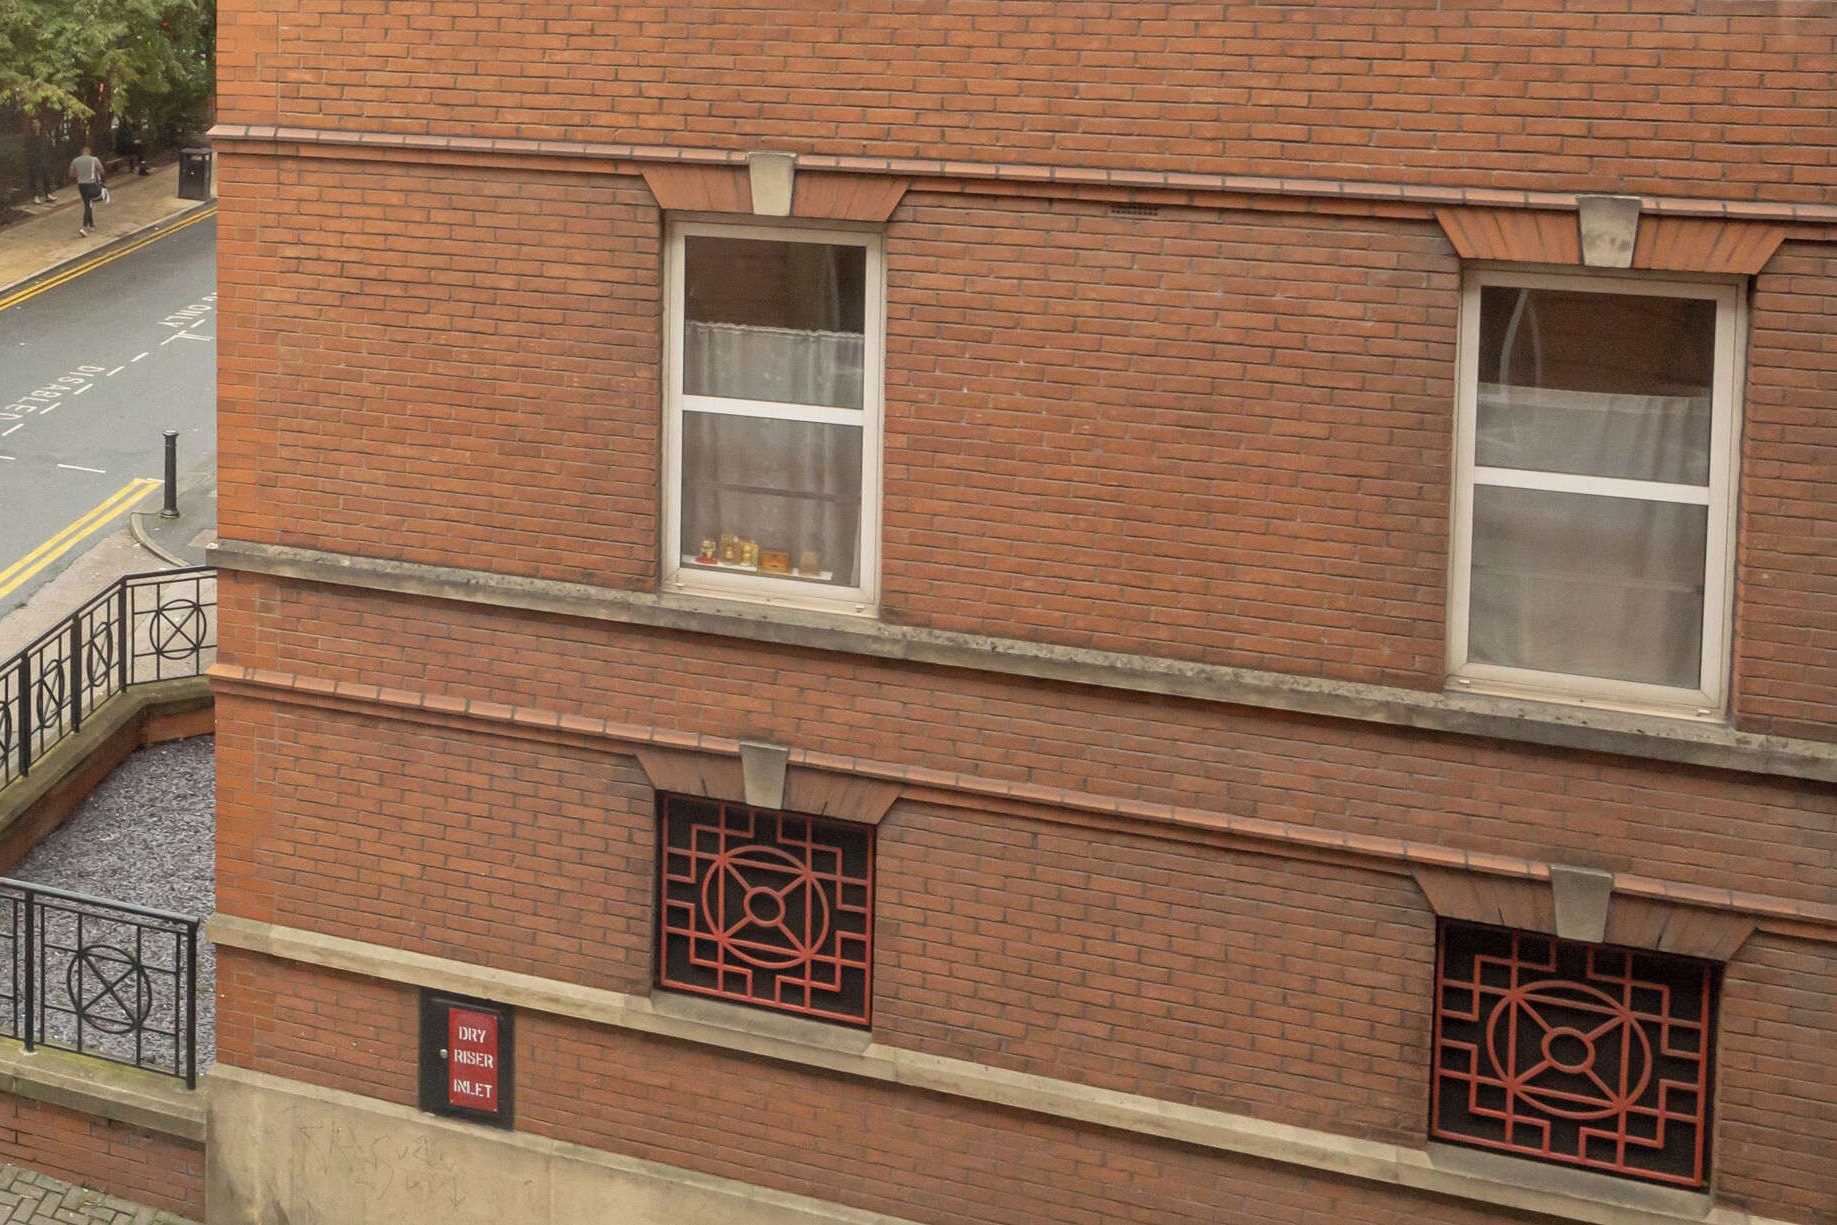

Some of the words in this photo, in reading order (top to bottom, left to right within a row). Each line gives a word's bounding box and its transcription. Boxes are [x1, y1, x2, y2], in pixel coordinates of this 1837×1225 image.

[158, 304, 212, 328] ONLY
[458, 1025, 487, 1044] DRY
[453, 1049, 494, 1069] RISER
[453, 1079, 493, 1099] INLET
